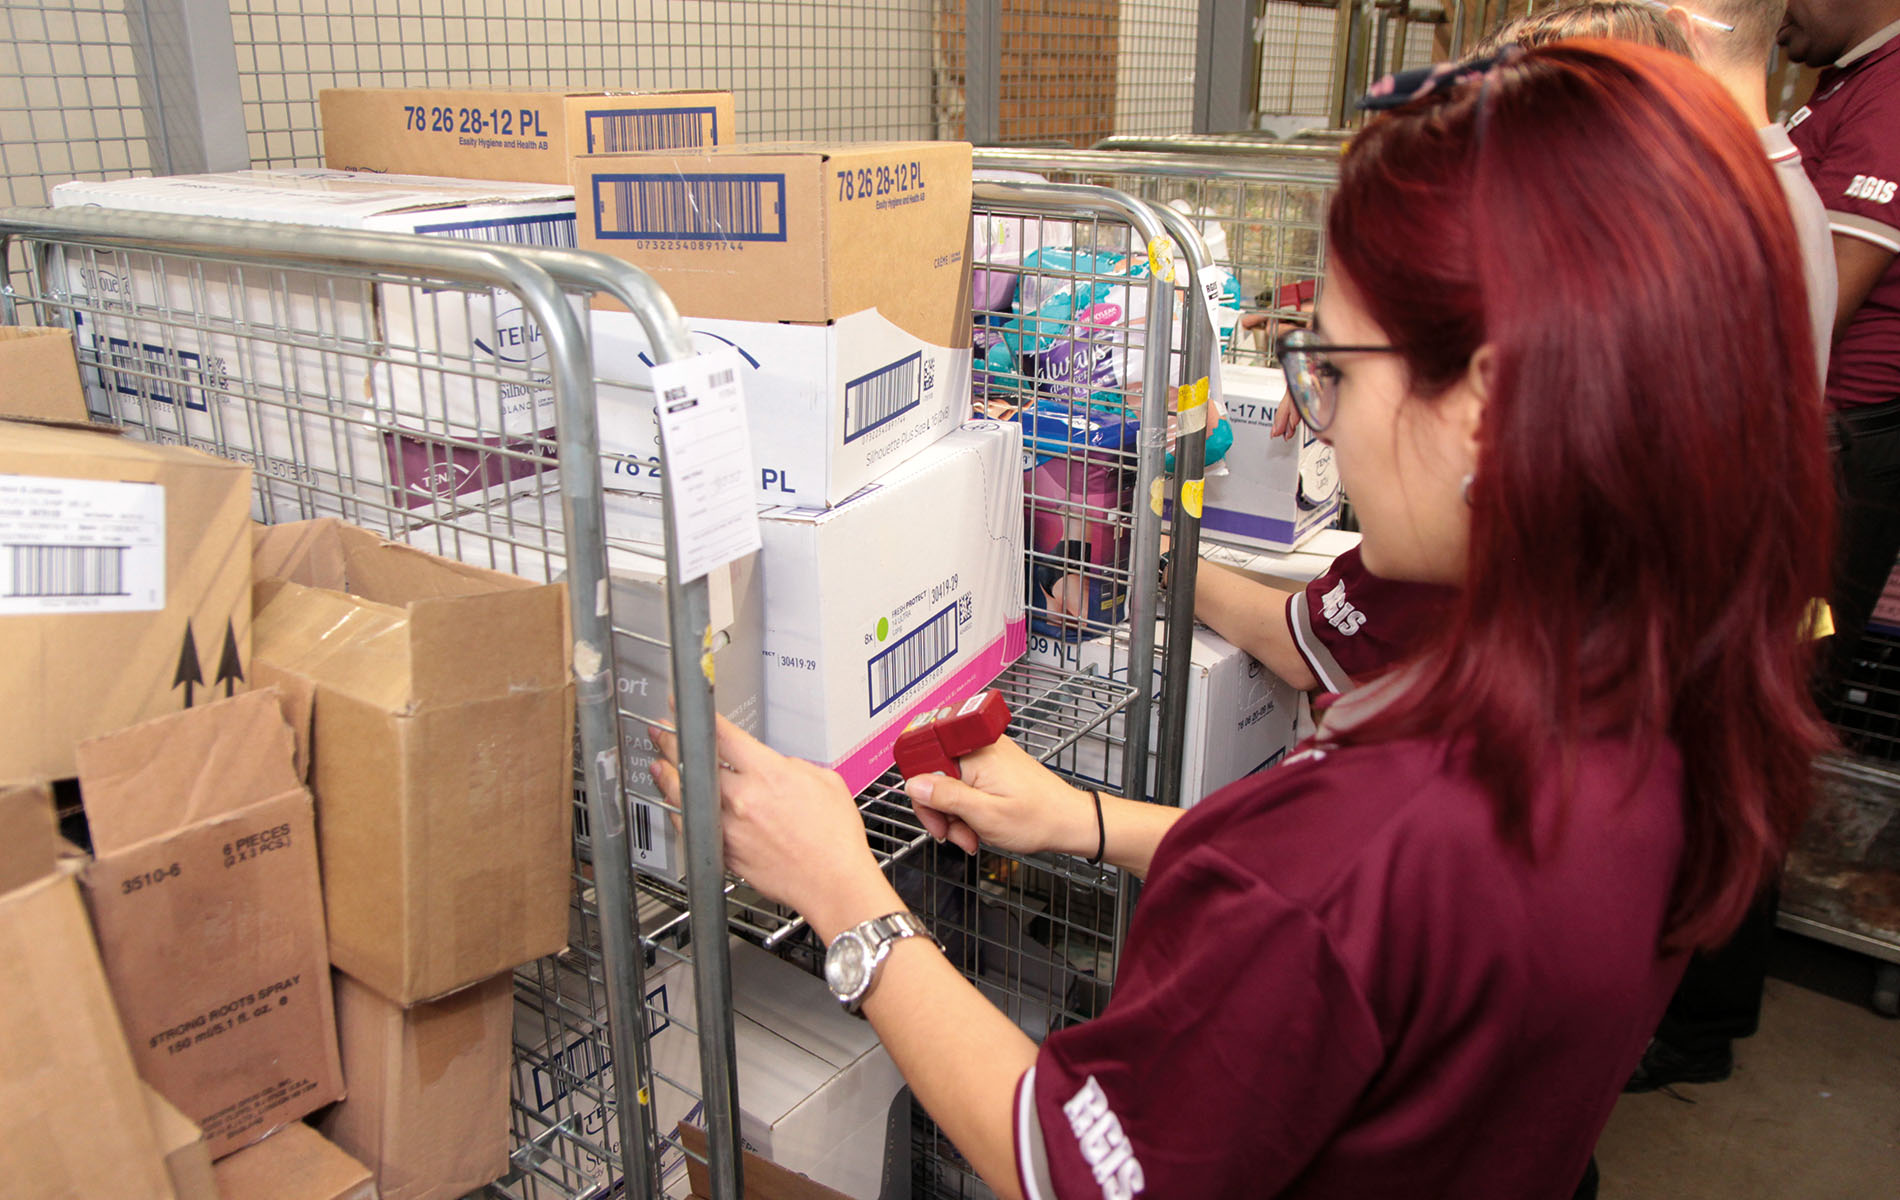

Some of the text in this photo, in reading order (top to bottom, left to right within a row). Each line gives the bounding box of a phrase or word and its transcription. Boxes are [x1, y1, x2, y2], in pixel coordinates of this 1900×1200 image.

[404, 106, 548, 137] 78 26 28-12 PL
[459, 136, 477, 148] Essity
[478, 138, 502, 149] Hygiene
[517, 140, 537, 150] Health
[538, 141, 548, 151] AB
[837, 161, 925, 202] 78 26 28-12 PL
[761, 468, 796, 494] PL
[931, 573, 959, 605] 30419-29
[864, 632, 874, 645] 8x
[781, 655, 817, 671] 30419-29
[618, 676, 649, 697] ort
[236, 823, 290, 851] PIECES
[640, 851, 647, 860] 6
[121, 862, 182, 895] 3510-6
[149, 974, 300, 1049] STRONG ROOTS SPRAY
[1062, 1073, 1145, 1200] RGIS
